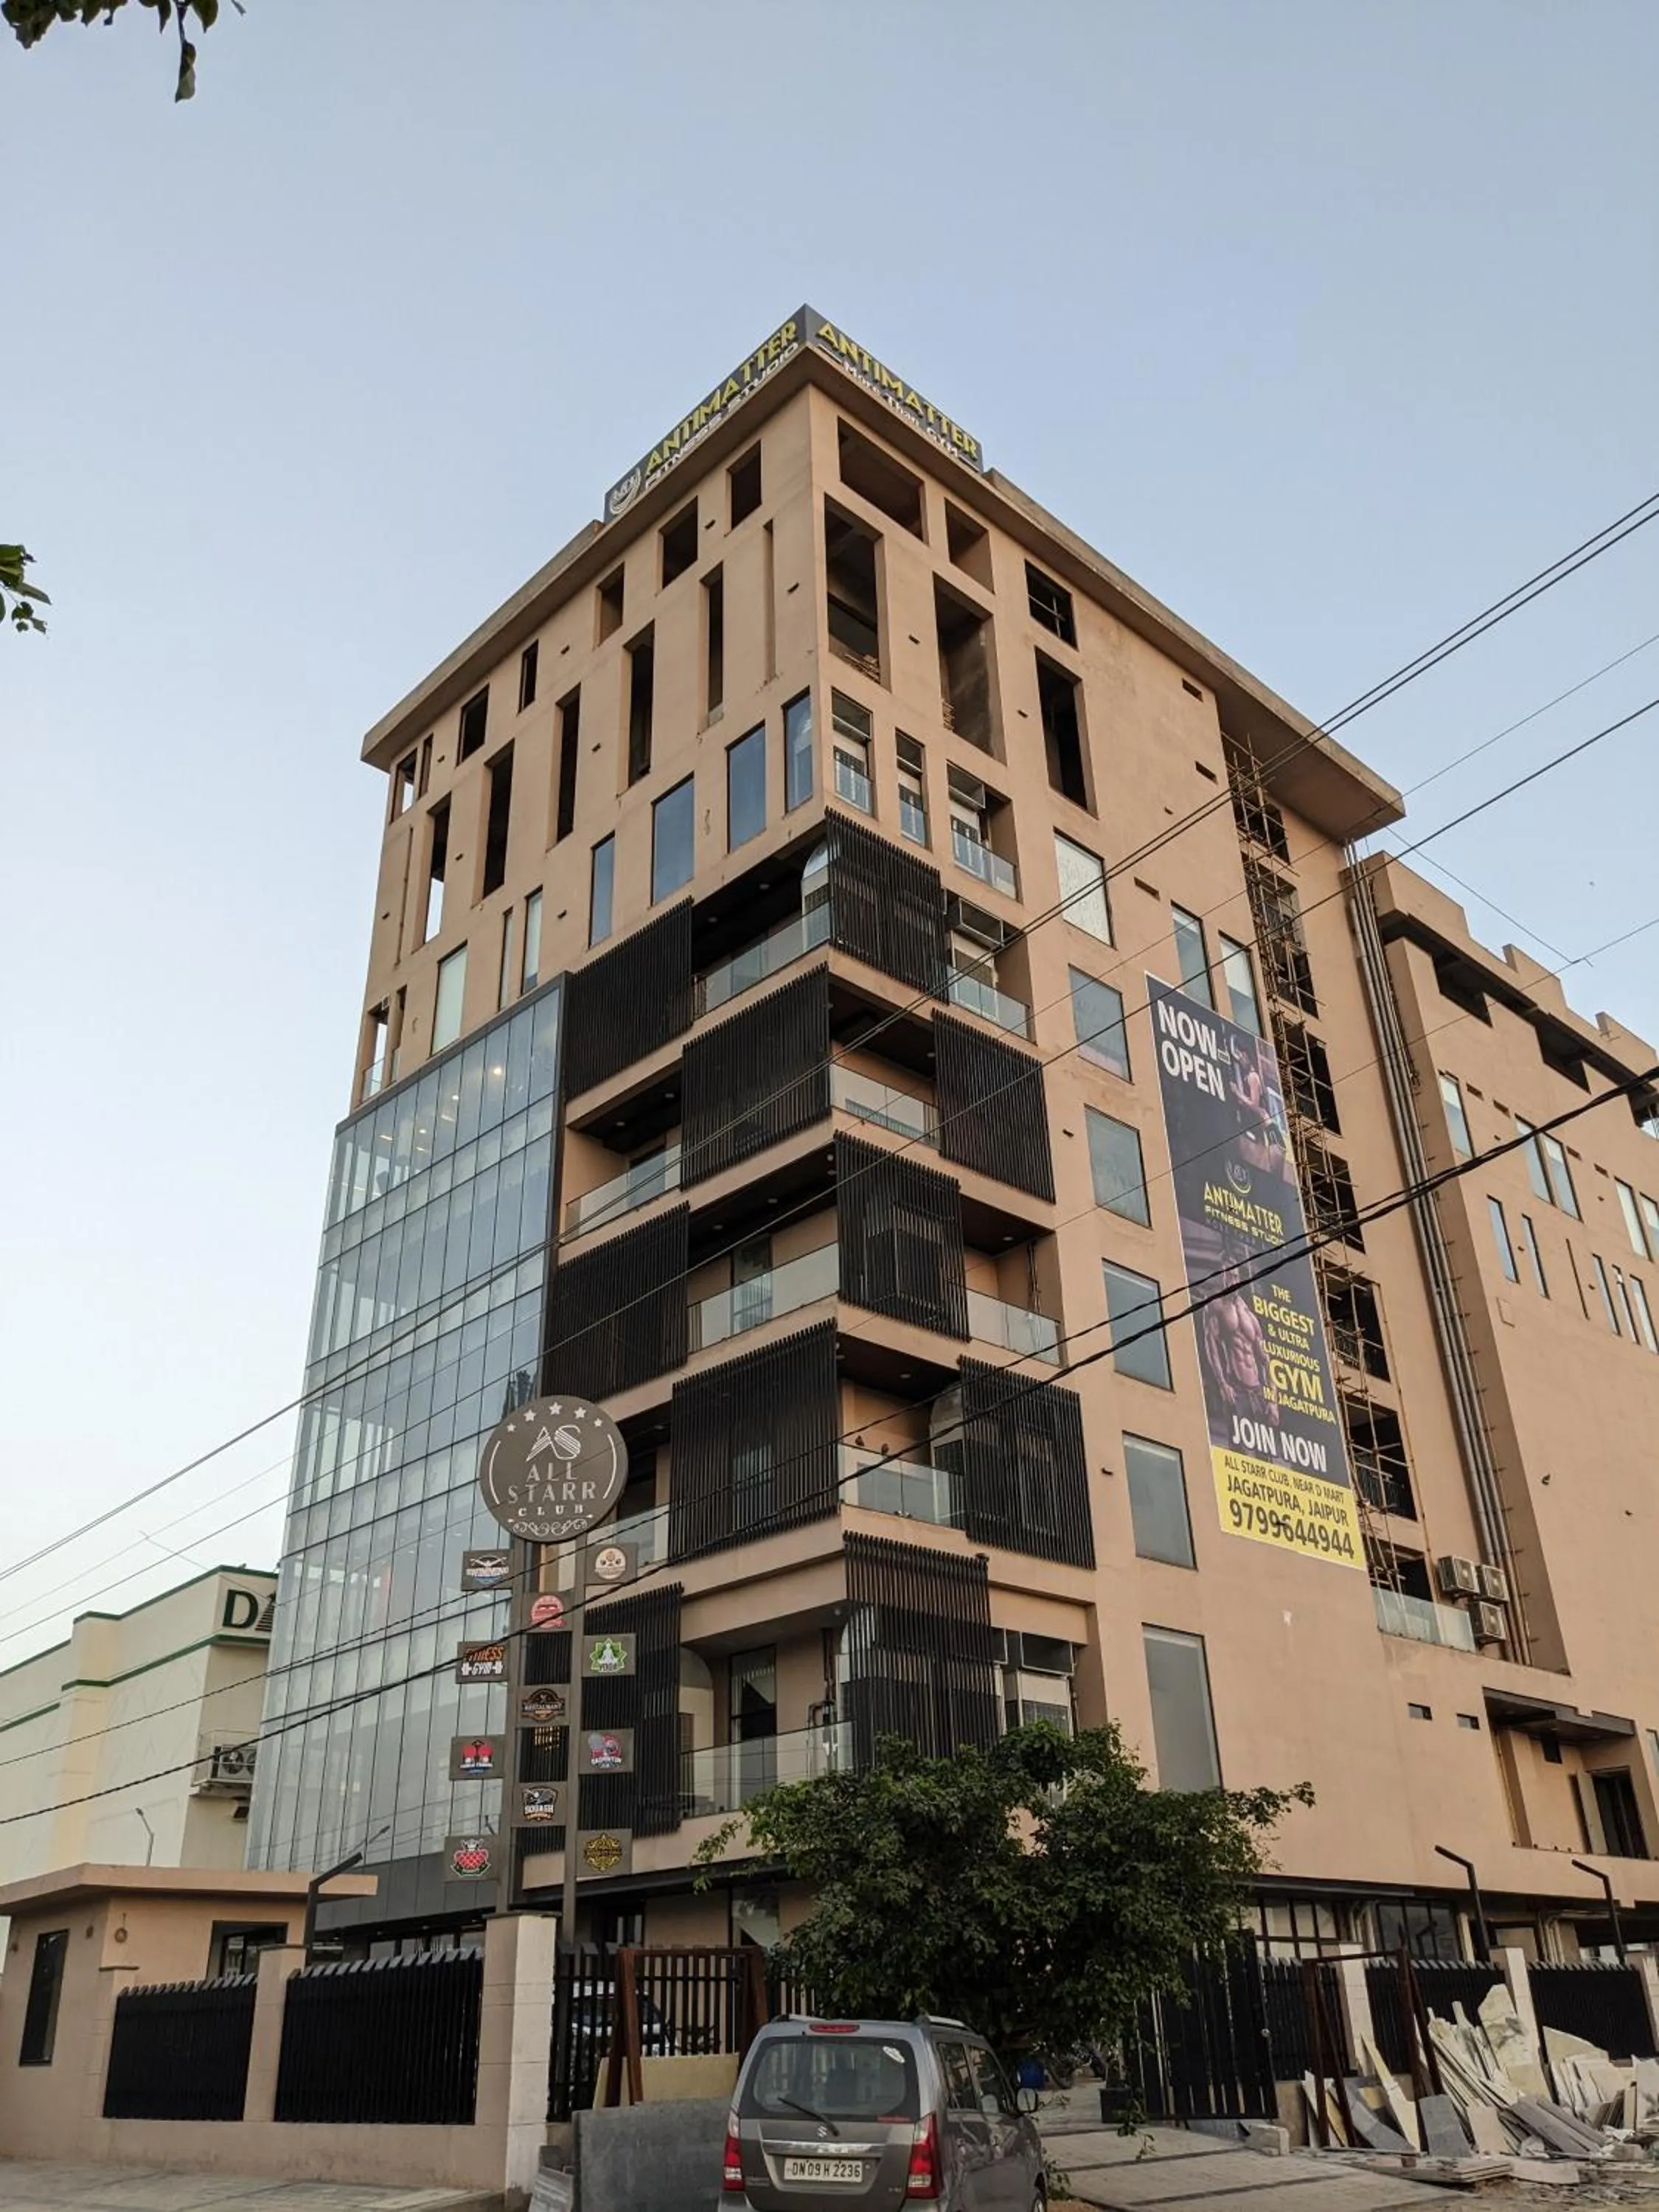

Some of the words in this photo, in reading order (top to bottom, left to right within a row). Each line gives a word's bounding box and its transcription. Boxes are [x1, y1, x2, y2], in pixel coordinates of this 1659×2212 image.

[645, 320, 796, 478] ANTIMATTER
[727, 341, 799, 413] STUDIO
[816, 322, 979, 459] ANTIMATTER
[1157, 999, 1218, 1061] NOW
[1161, 1040, 1225, 1102] OPEN
[1203, 1180, 1284, 1237] ANTIMATTER
[1204, 1204, 1248, 1233] FITNESS
[1253, 1295, 1315, 1337] BIGGEST
[1271, 1284, 1292, 1304] THE
[1262, 1339, 1320, 1372] LUXURIOUS
[1267, 1323, 1276, 1338] &
[1278, 1327, 1310, 1351] ULTRA
[1269, 1358, 1324, 1405] GYM
[1262, 1385, 1276, 1403] IN
[1278, 1391, 1338, 1426] JAGATPURA
[1232, 1415, 1277, 1456] JOIN
[1280, 1431, 1326, 1472] NOW
[508, 1481, 597, 1504] STARR
[526, 1461, 577, 1482] ALL
[1225, 1455, 1240, 1472] ALL
[1241, 1461, 1266, 1481] STARR
[1293, 1476, 1315, 1494] NEAR
[1315, 1484, 1322, 1498] D
[1324, 1486, 1345, 1505] MART
[518, 1504, 583, 1517] CLUB
[1227, 1474, 1304, 1516] JAGATPURA,
[1308, 1499, 1349, 1526] JAIPUR
[1229, 1498, 1354, 1559] 9799644944
[524, 1804, 554, 1815] SQUASH
